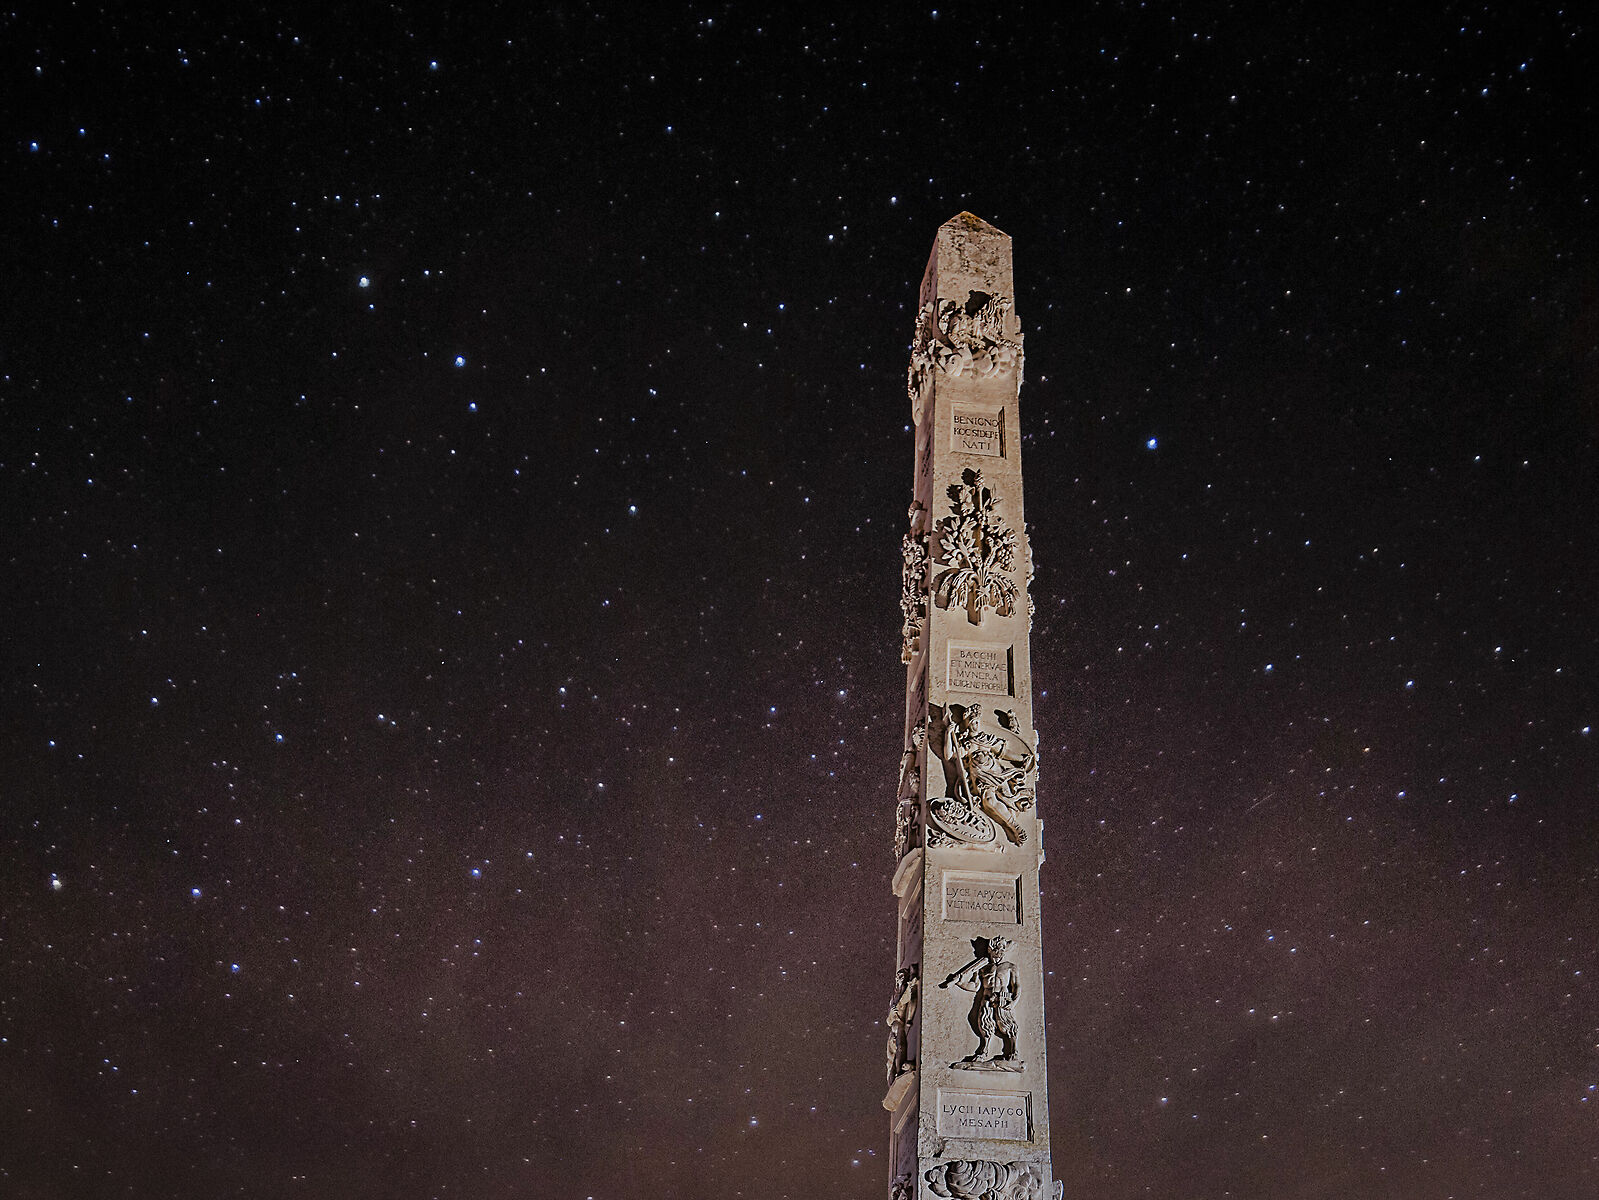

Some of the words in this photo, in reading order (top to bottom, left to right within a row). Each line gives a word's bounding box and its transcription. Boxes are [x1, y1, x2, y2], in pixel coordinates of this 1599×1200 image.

[954, 416, 998, 427] BENIGNO
[962, 440, 990, 450] NATI
[960, 650, 996, 660] BACCHI
[950, 660, 962, 668] ET
[964, 661, 1006, 672] MINERVAE
